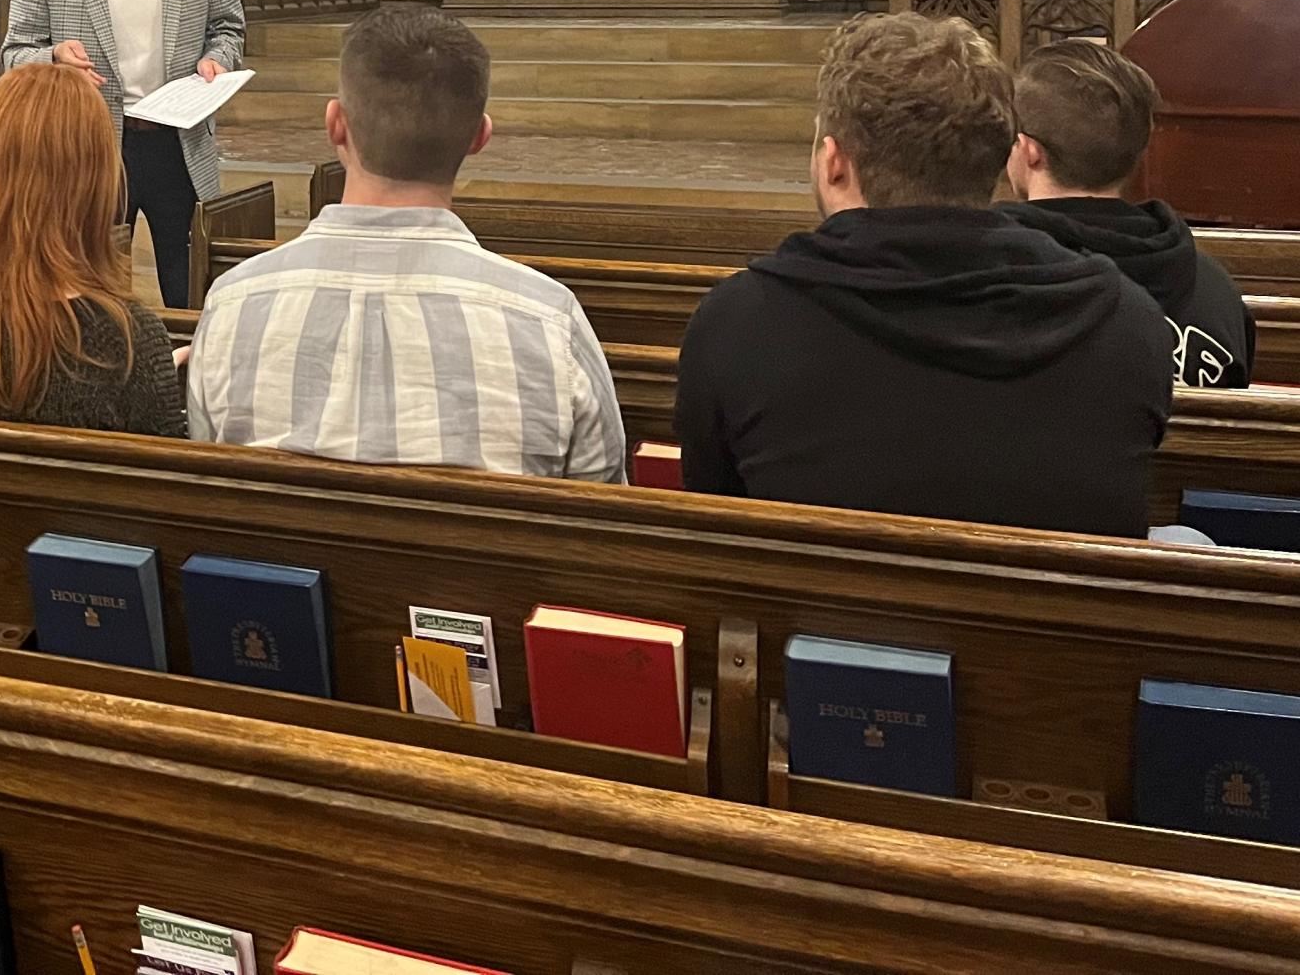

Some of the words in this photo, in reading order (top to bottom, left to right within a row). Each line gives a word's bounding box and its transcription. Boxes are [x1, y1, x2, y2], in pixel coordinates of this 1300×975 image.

[50, 589, 88, 604] HOLY
[88, 594, 127, 610] BIBLE
[819, 704, 869, 720] HOLY
[875, 710, 927, 727] BIBLE
[140, 918, 170, 937] Get
[170, 923, 232, 948] Involved
